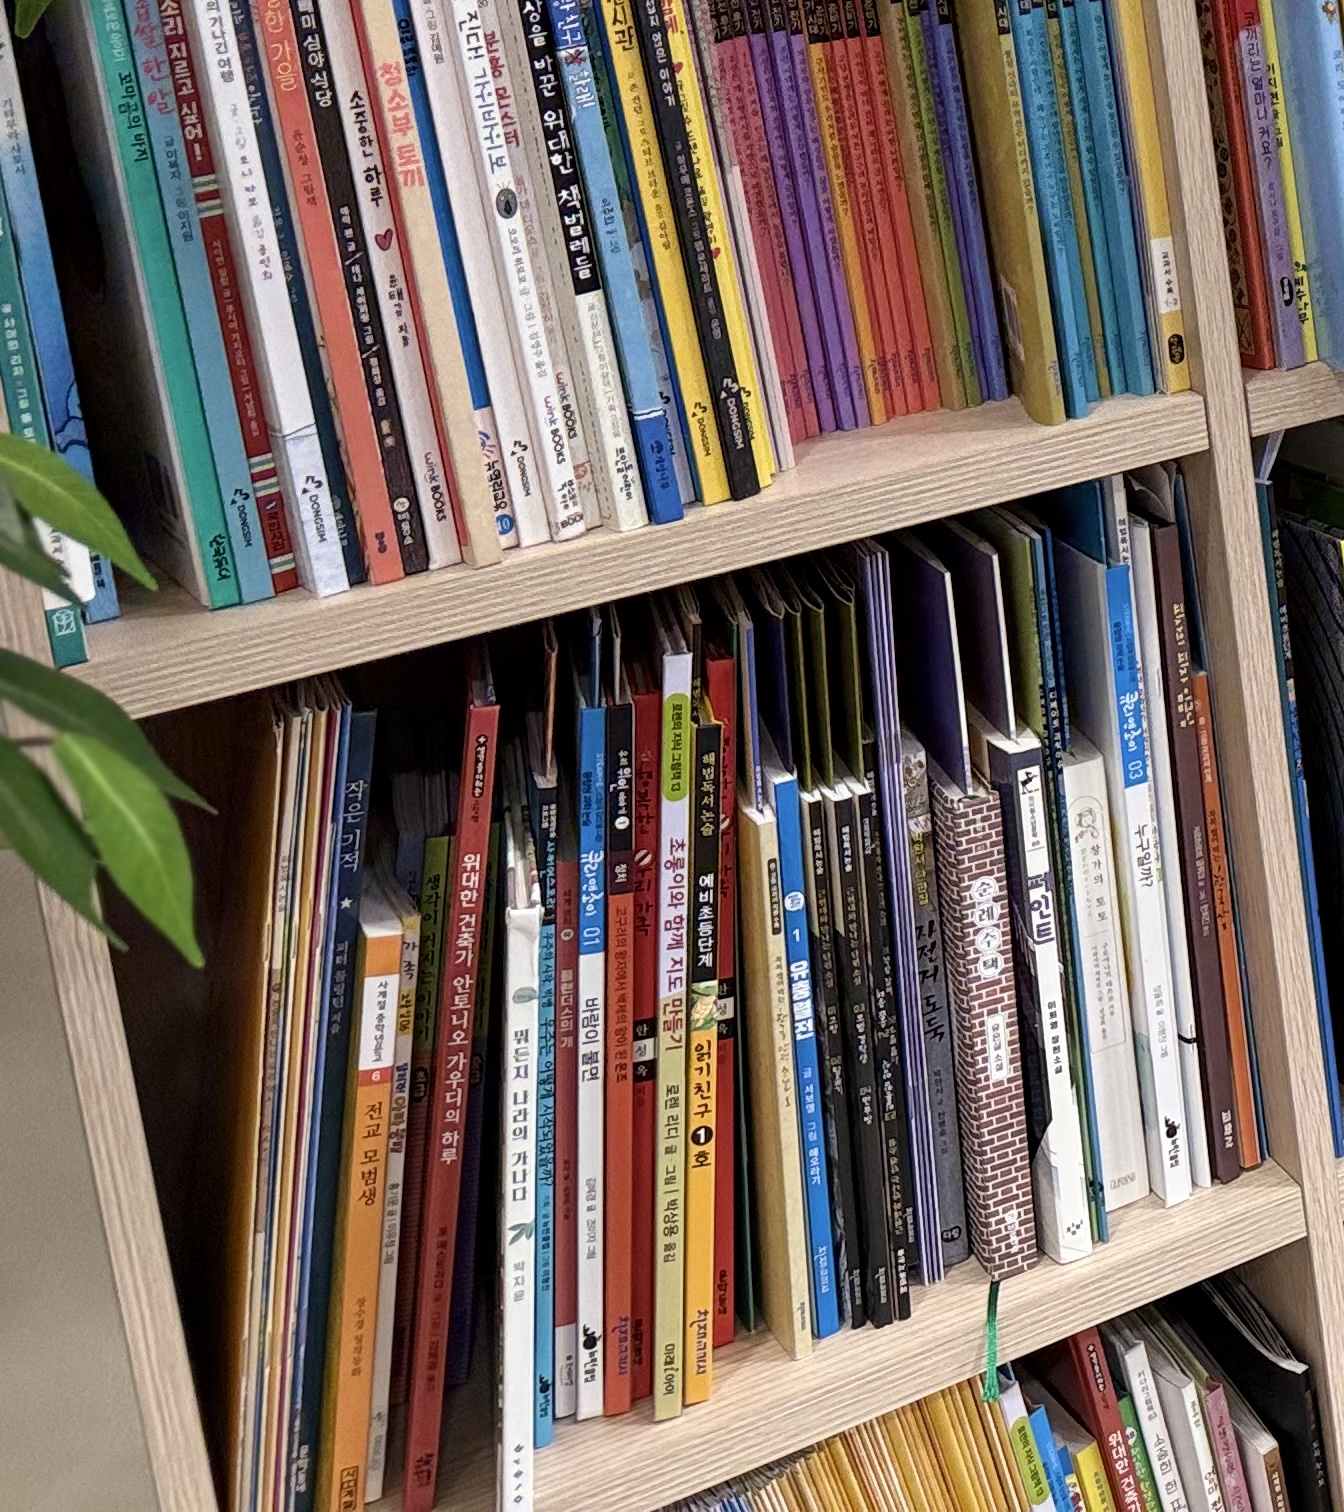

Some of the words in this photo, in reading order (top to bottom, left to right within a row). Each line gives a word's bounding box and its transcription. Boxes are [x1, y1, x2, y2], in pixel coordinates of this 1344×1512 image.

[168, 41, 193, 96] 지르고
[269, 42, 297, 93] 가을
[302, 34, 326, 68] 심야
[651, 33, 668, 63] 않은
[311, 69, 333, 109] 식당
[378, 60, 414, 137] 청소부
[458, 11, 483, 61] 진다!
[471, 67, 508, 174] 가위바위보
[533, 54, 557, 98] 바꾼
[657, 67, 676, 108] 이야기
[179, 100, 204, 162] 싶어!
[348, 90, 373, 161] 소중한
[364, 164, 383, 208] 하루
[542, 108, 573, 177] 위대한
[395, 144, 426, 190] 토끼
[558, 183, 593, 282] 책벌레들
[550, 427, 567, 464] BOOKS
[726, 397, 745, 451] DONGSIM
[341, 780, 370, 822] 작은
[340, 832, 363, 872] 기적
[667, 836, 687, 910] 초롱이와
[1133, 823, 1154, 888] 누구일까?
[458, 853, 483, 909] 위대한
[453, 913, 477, 966] 건축가
[667, 915, 687, 951] 함께
[913, 915, 940, 995] 자전거
[666, 956, 687, 992] 지도
[447, 975, 476, 1047] 안토니오
[580, 996, 600, 1045] 바람이
[663, 997, 686, 1052] 만들기
[920, 998, 949, 1043] 도둑
[511, 1028, 532, 1081] 뭐든지
[581, 1049, 601, 1084] 불면
[443, 1053, 469, 1124] 가우디의
[361, 1102, 384, 1140] 전교
[510, 1090, 532, 1141] 나라의
[438, 1130, 462, 1165] 하루
[357, 1149, 381, 1206] 모범생
[510, 1151, 530, 1202] 가나다
